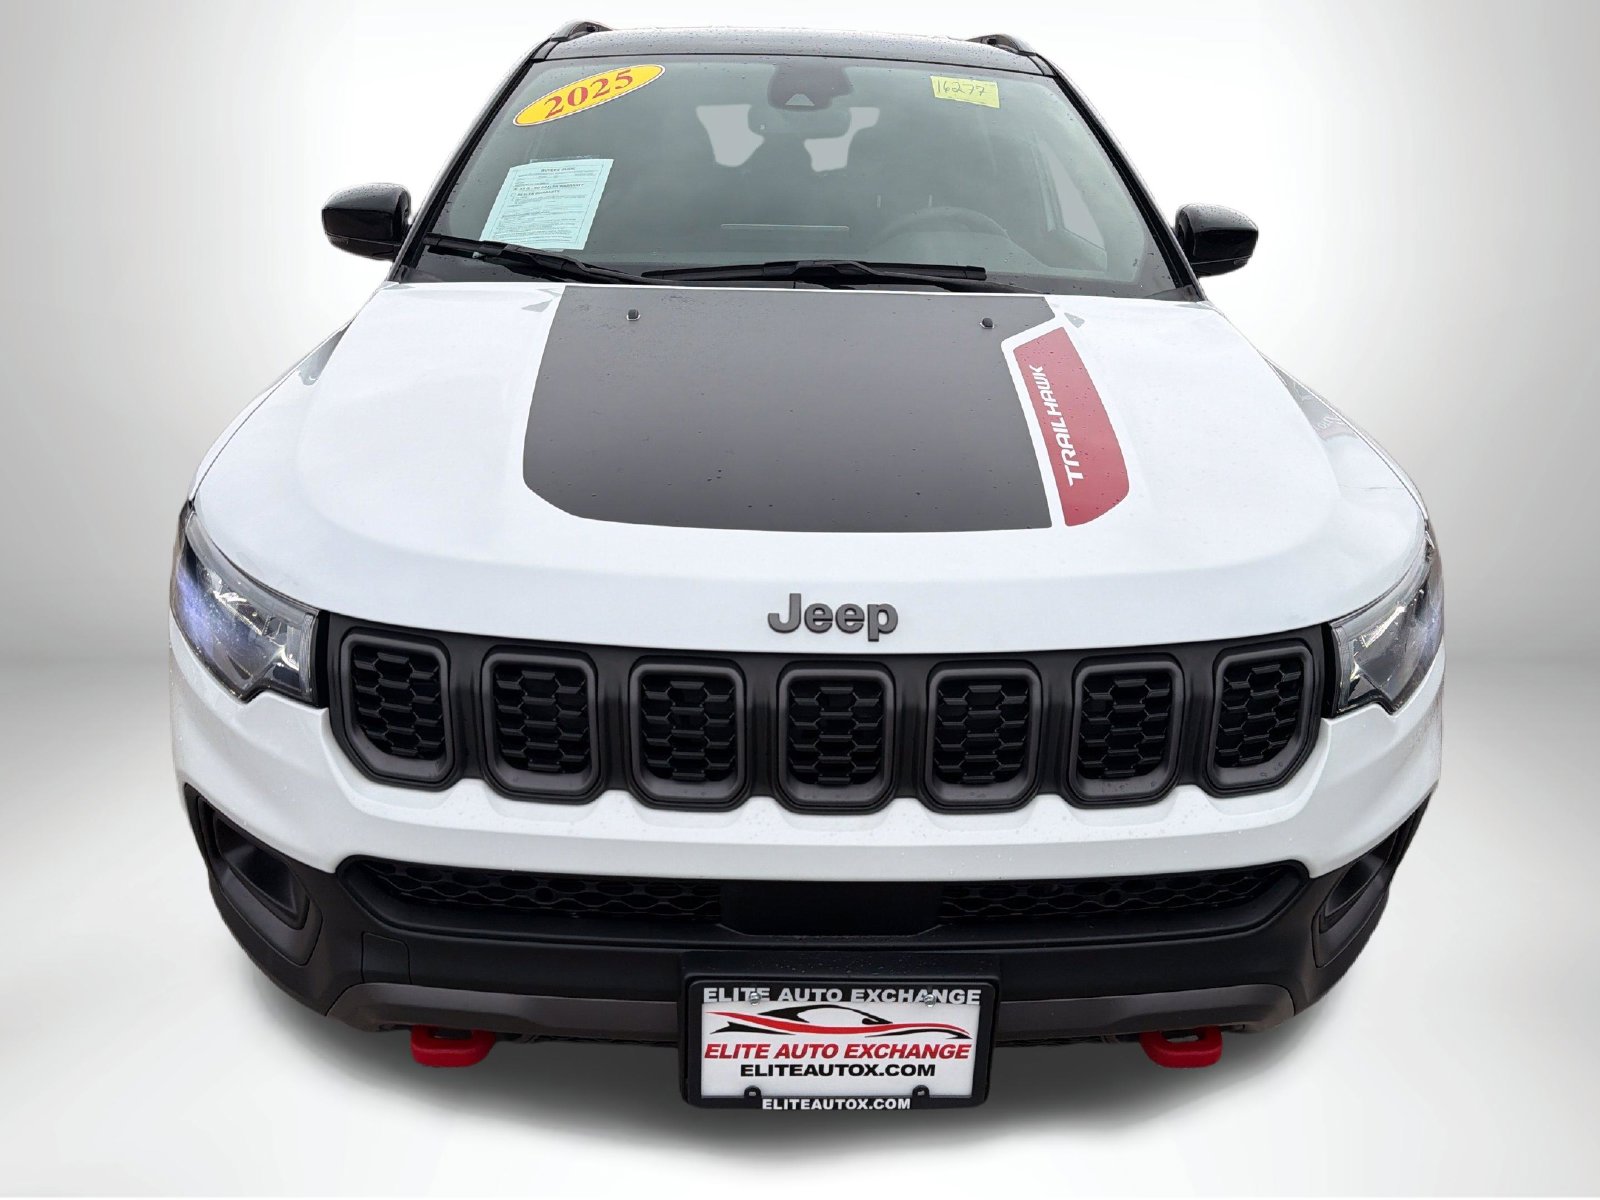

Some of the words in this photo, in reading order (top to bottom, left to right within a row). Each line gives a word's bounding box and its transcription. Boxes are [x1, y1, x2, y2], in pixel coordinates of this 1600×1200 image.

[543, 68, 634, 119] 2025
[937, 79, 986, 97] 16277
[1028, 364, 1084, 487] TRAILHAWK
[767, 592, 899, 642] Jeep
[703, 987, 771, 1003] ELITE
[778, 987, 843, 1003] AUTO
[850, 988, 982, 1005] EXCHANGE
[704, 1043, 771, 1060] ELITE
[773, 1043, 839, 1060] AUTO
[843, 1043, 972, 1060] EXCHANGE
[740, 1063, 936, 1077] ELITEAUTOX.COM
[761, 1097, 911, 1111] ELITEAUTOX.COM
